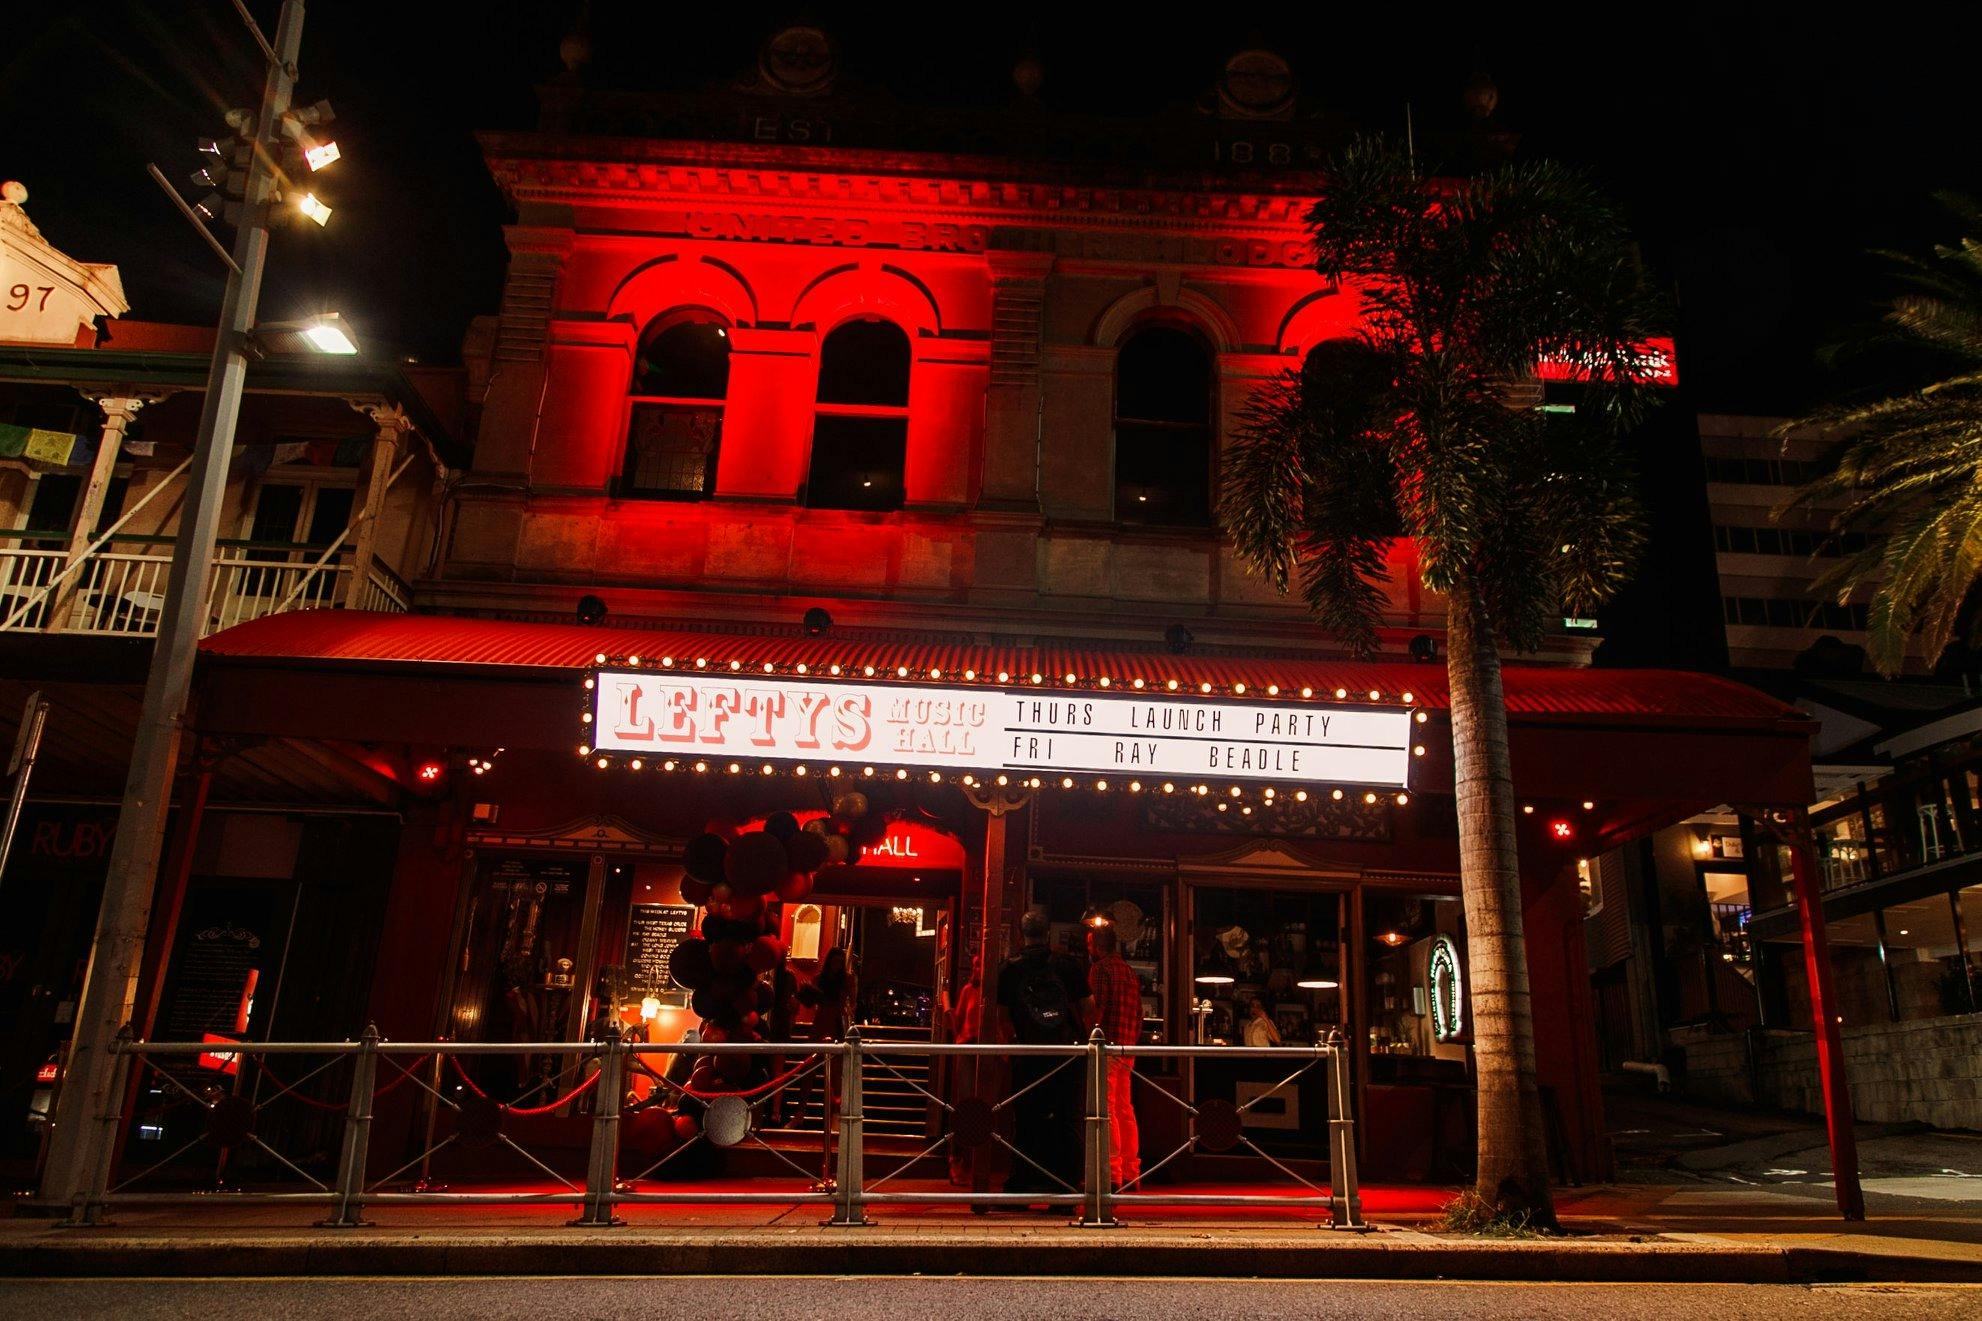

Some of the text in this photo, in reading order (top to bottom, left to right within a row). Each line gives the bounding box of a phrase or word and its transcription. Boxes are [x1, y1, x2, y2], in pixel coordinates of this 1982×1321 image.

[7, 284, 55, 312] 97
[614, 682, 872, 751] LEFTYS
[887, 696, 987, 727] MUSIC
[1016, 700, 1333, 738] THURS LAUNCH PARTY
[893, 729, 976, 755] HALL
[1013, 736, 1301, 772] FRI RAY BEADLE
[31, 820, 118, 858] RUBY
